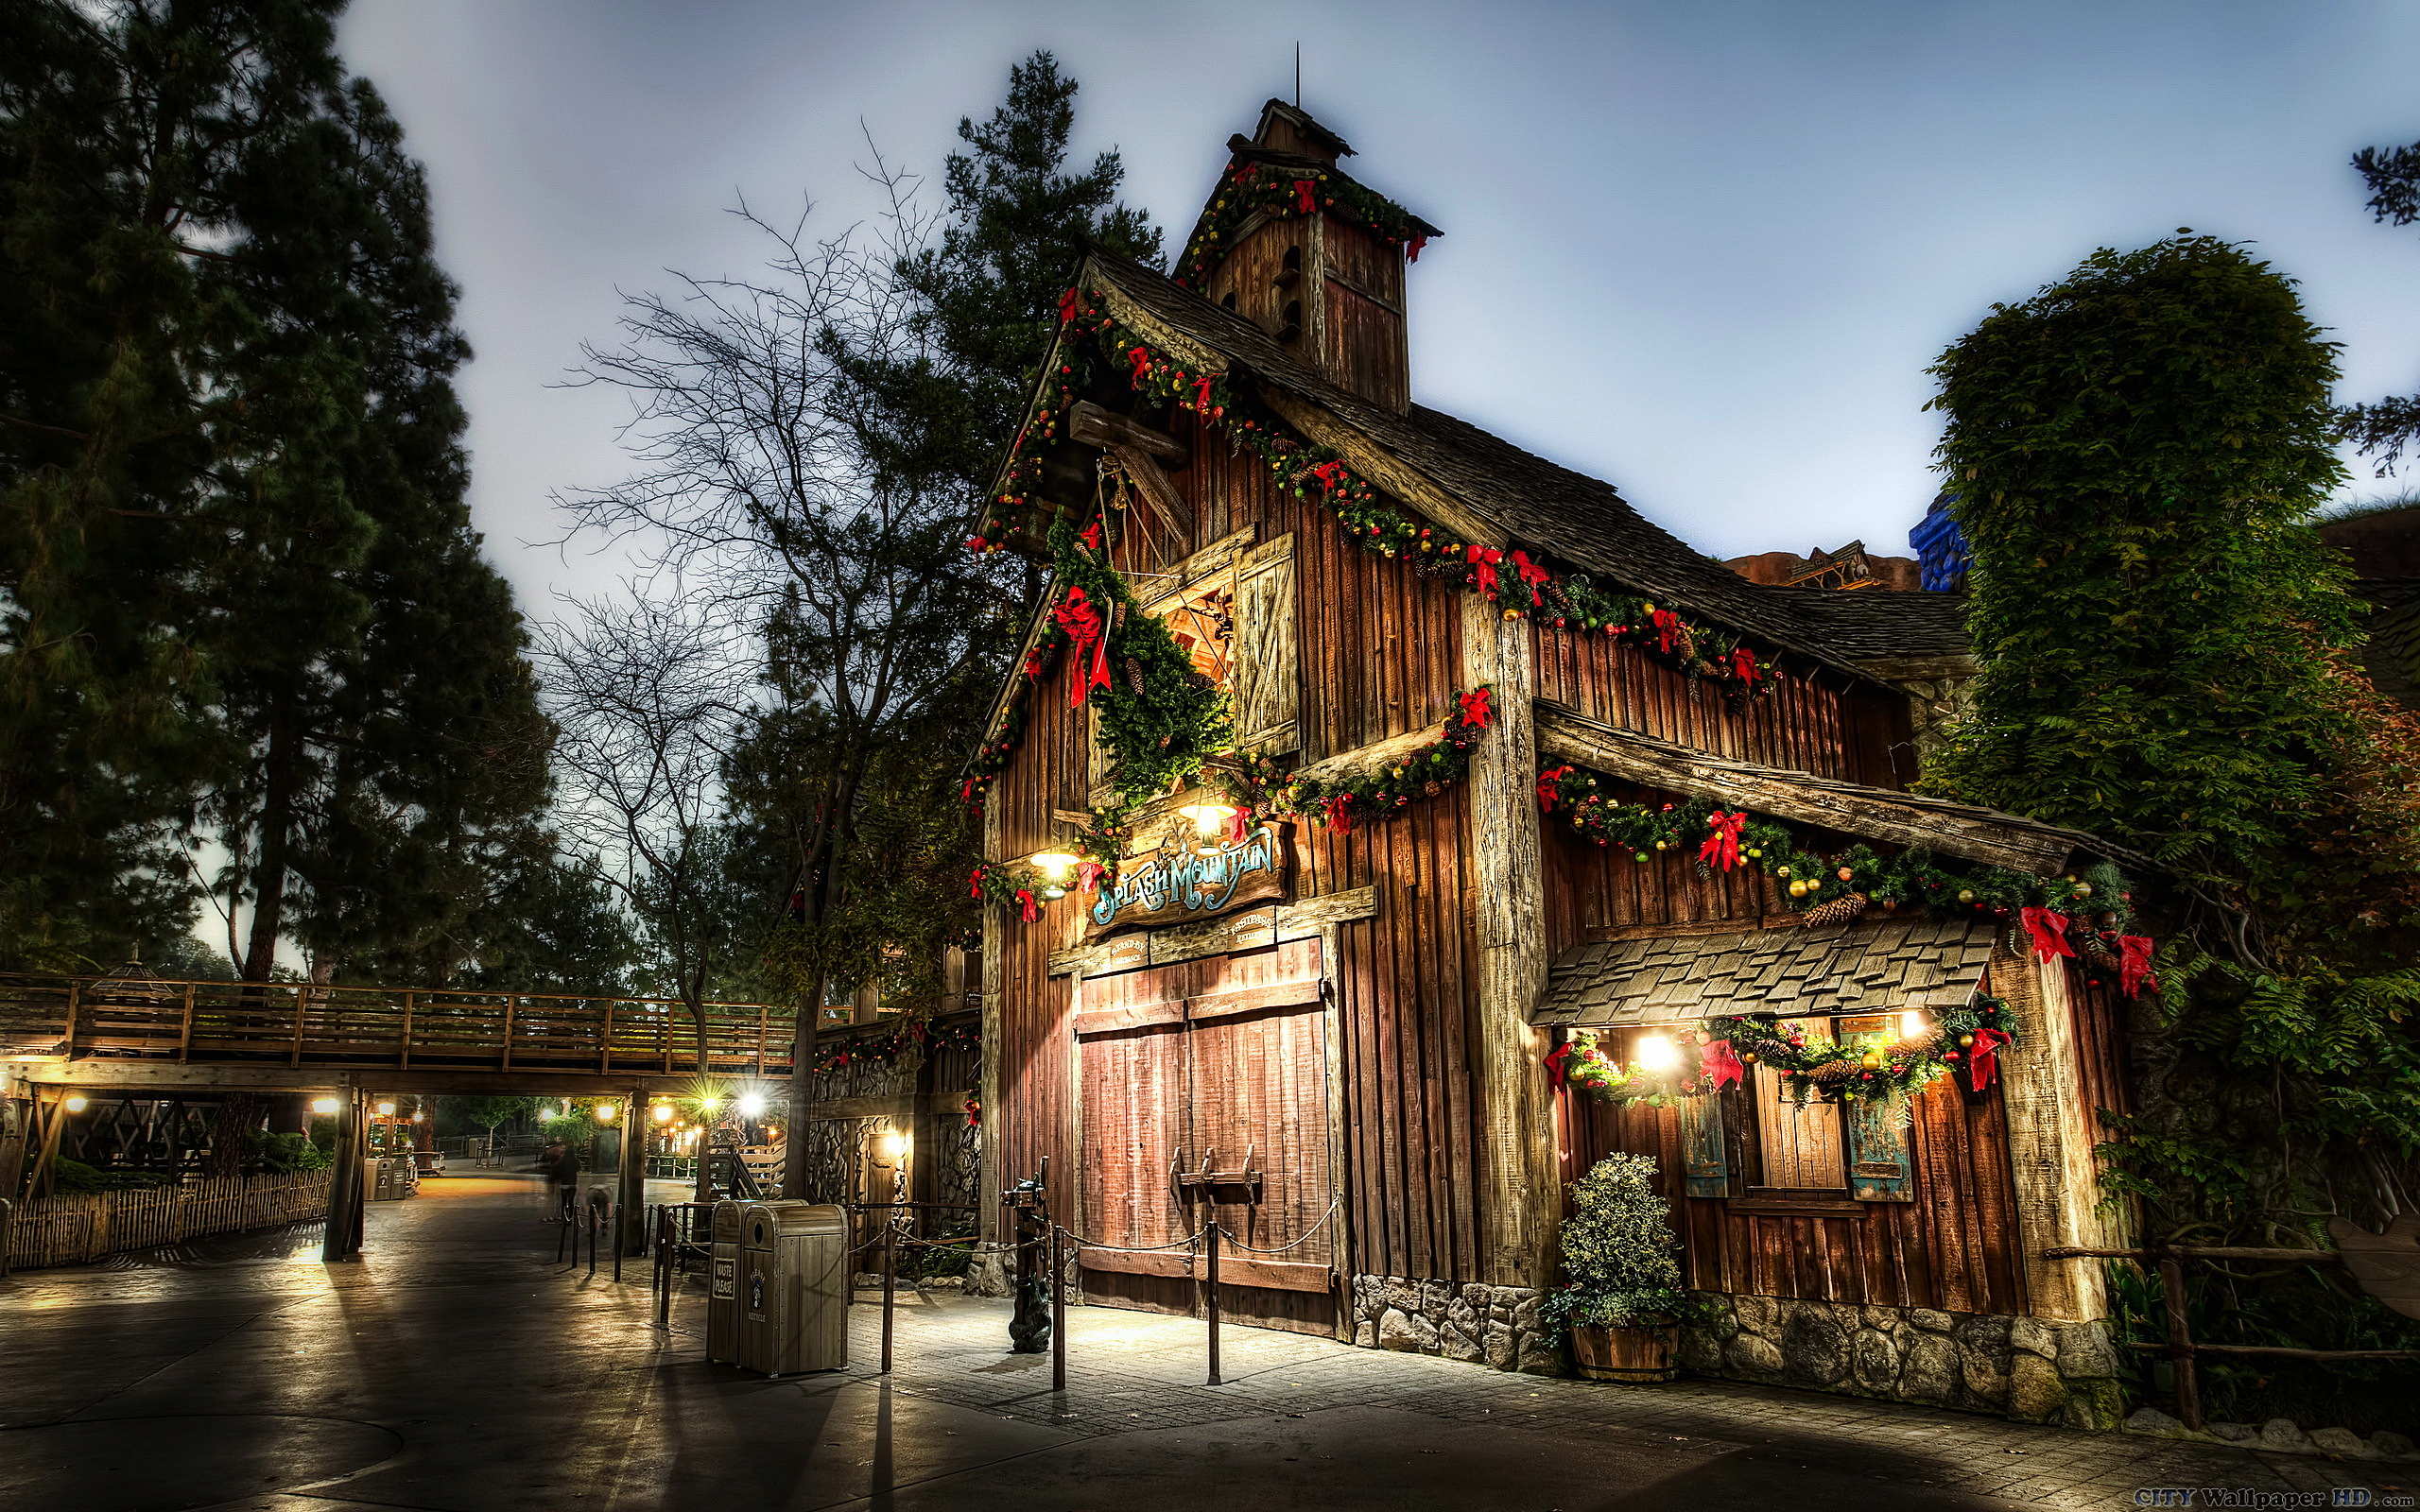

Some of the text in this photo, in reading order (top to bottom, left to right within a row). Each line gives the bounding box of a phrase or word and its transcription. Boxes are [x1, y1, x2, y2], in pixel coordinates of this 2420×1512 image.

[1093, 827, 1272, 925] SPLASH MOUNTAIN
[717, 1263, 733, 1278] WASTE
[715, 1279, 733, 1294] PLEASE
